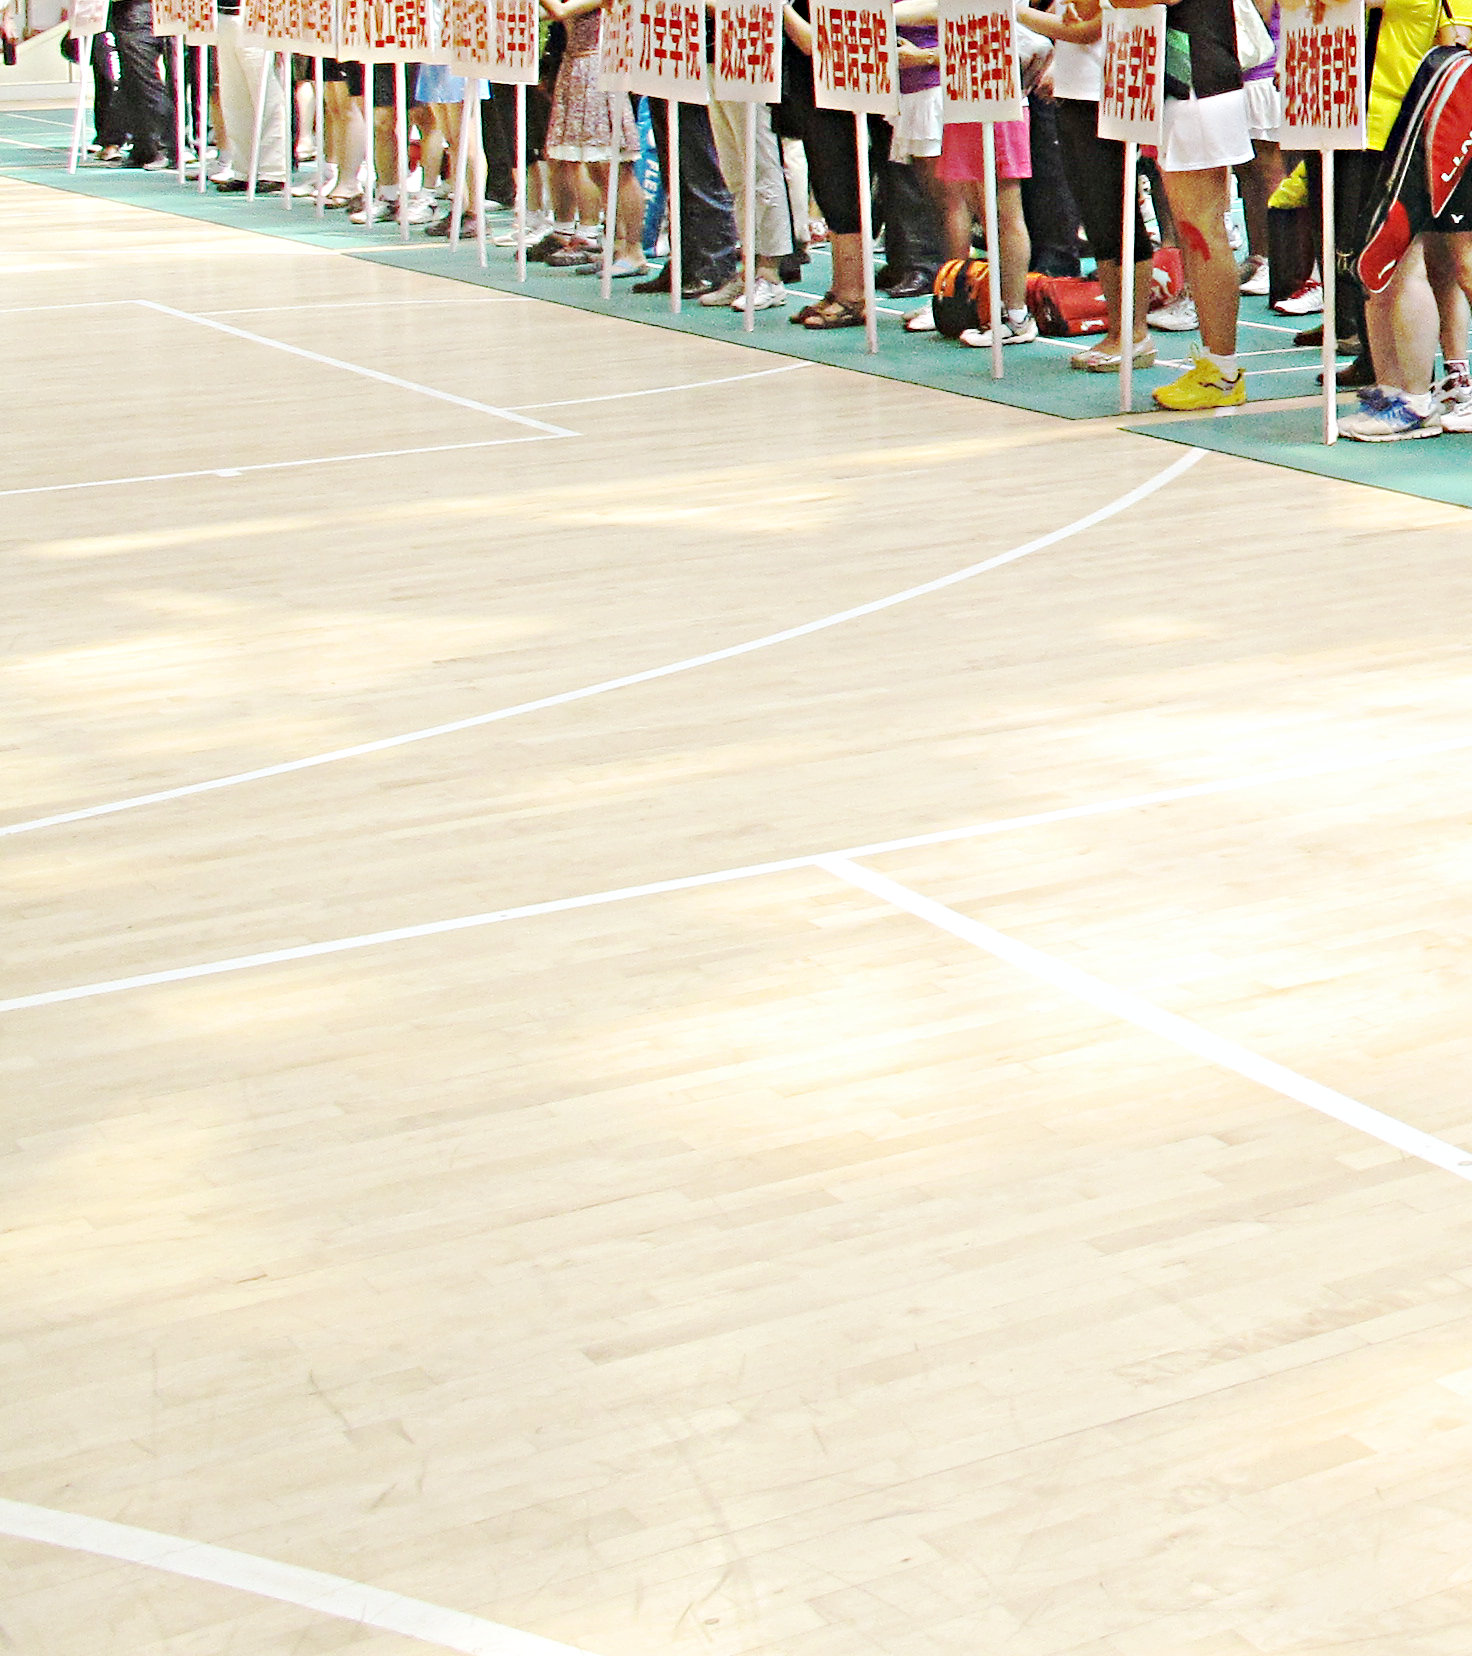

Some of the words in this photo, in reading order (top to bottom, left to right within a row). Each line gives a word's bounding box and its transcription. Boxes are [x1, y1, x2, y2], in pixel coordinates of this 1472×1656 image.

[639, 0, 701, 81] 力学学院
[720, 4, 775, 84] 政法学院
[815, 6, 891, 95] 外国语学院
[944, 12, 1015, 102] 经济管理学院
[1103, 24, 1157, 122] 体育学院
[1285, 24, 1359, 129] 继续教育学院
